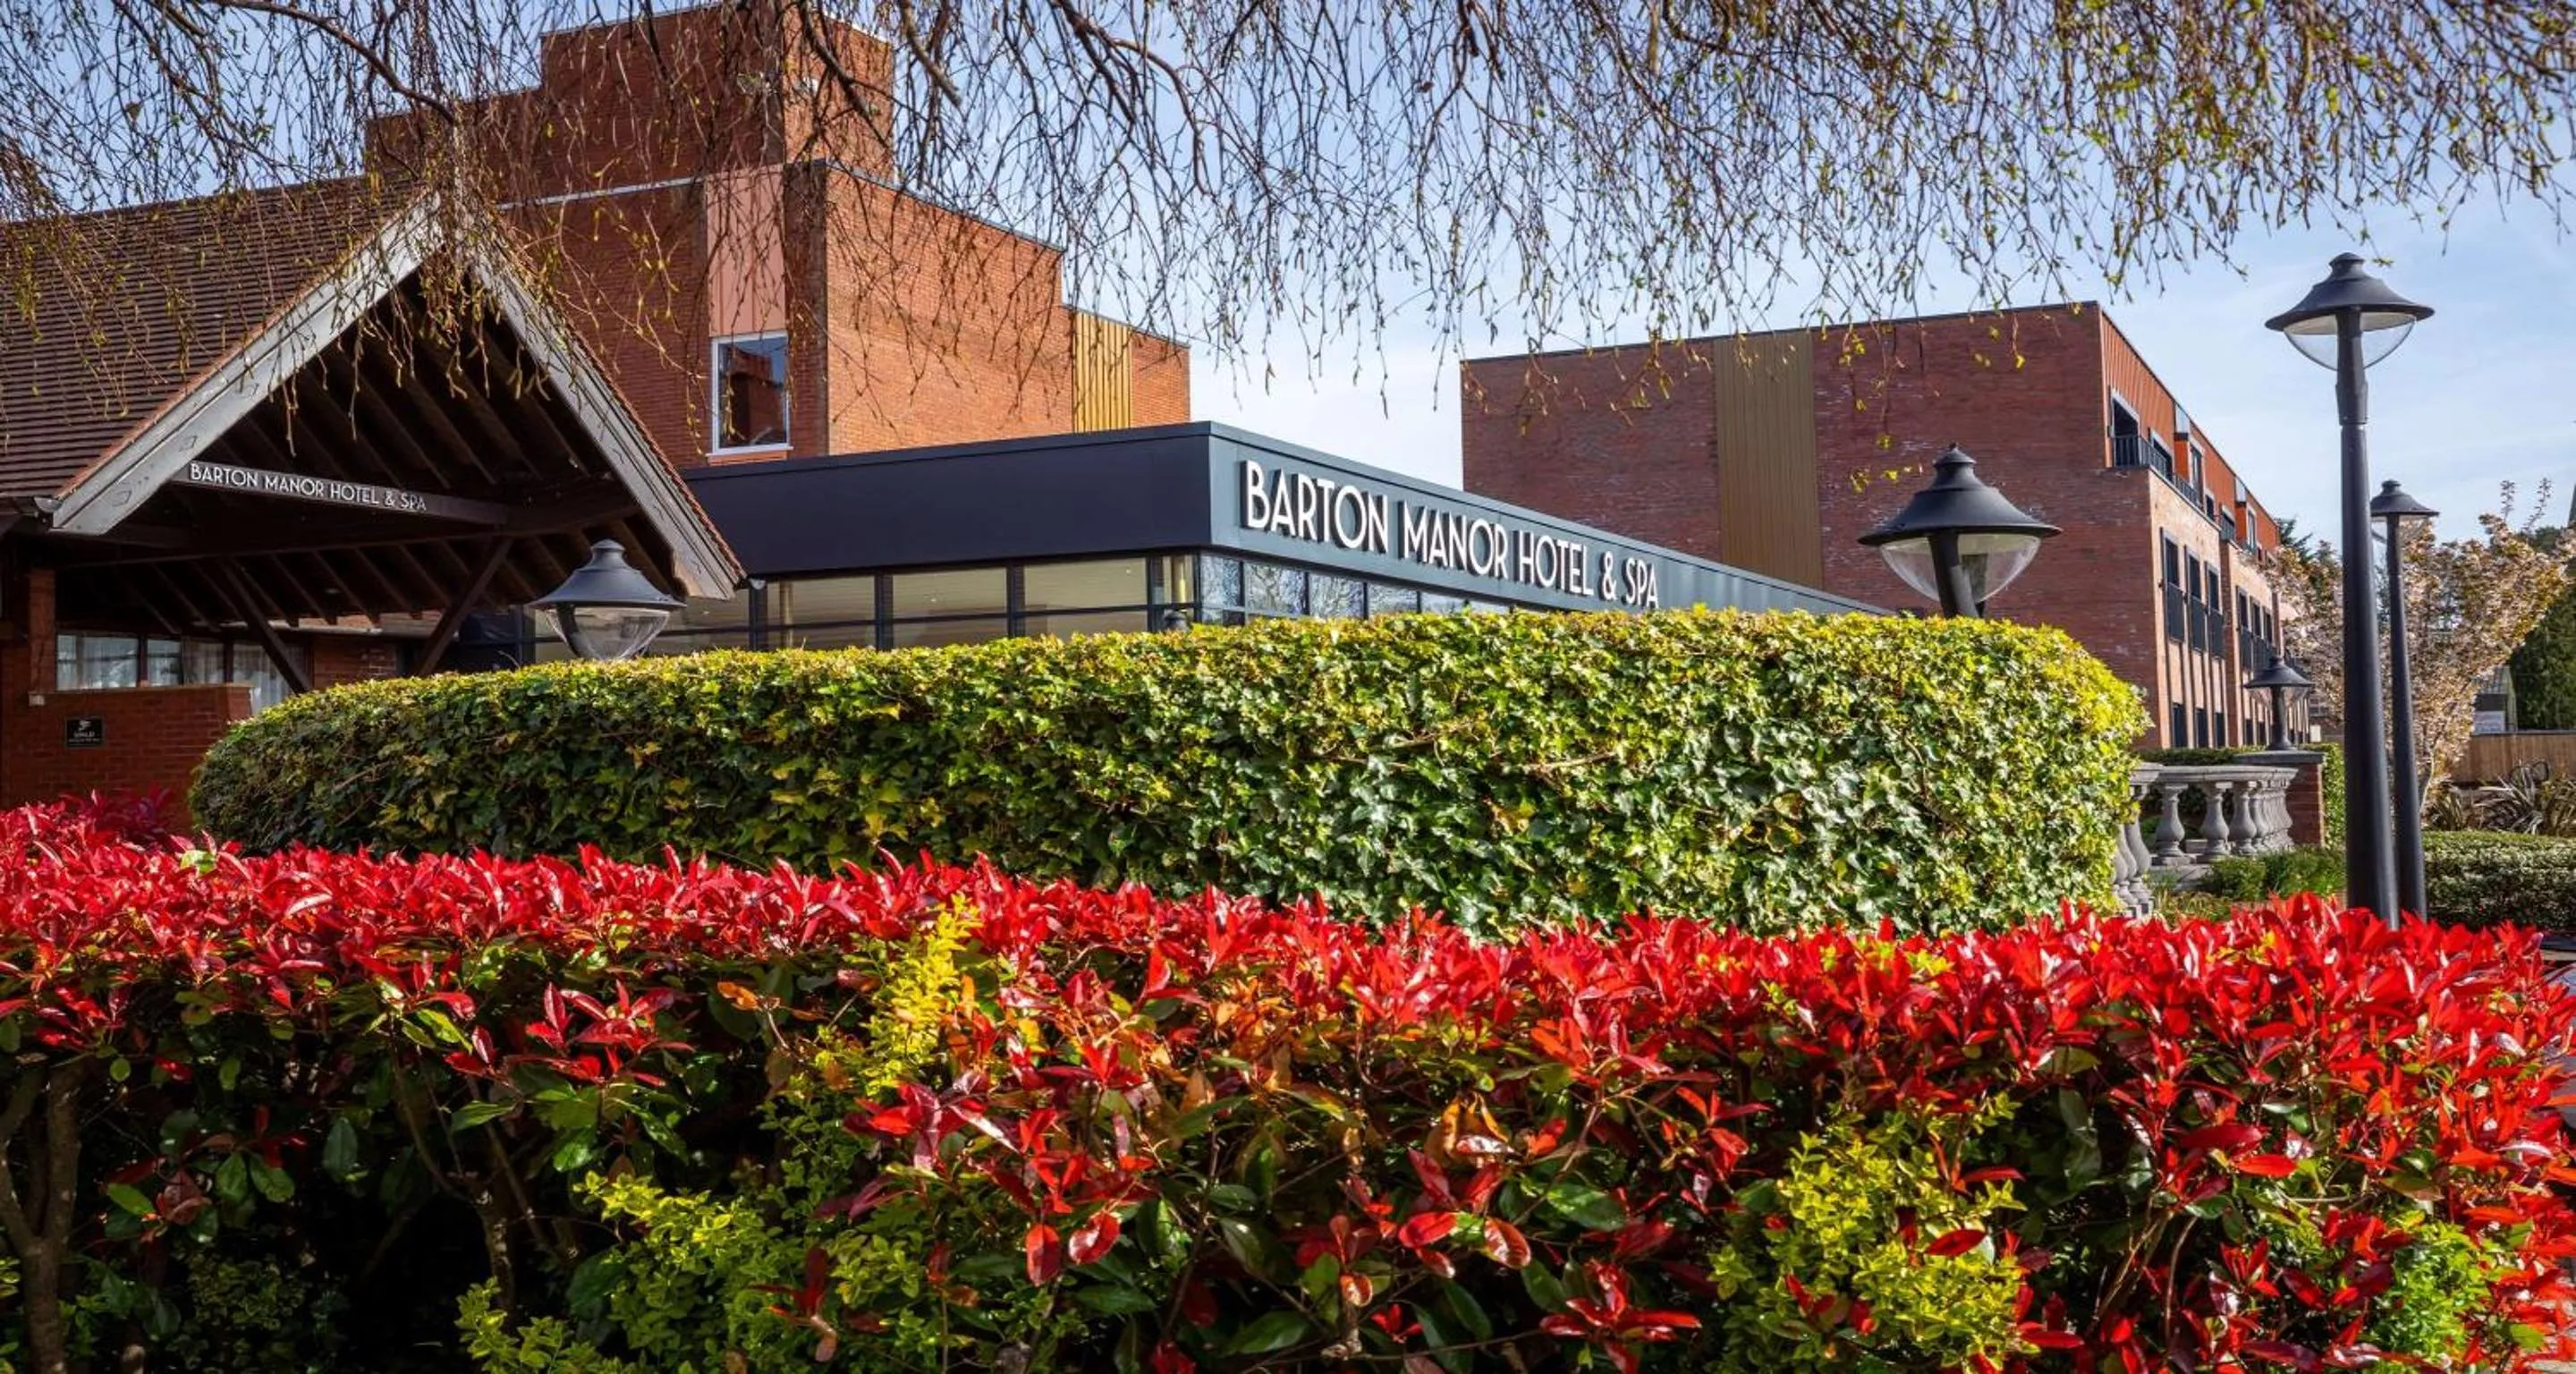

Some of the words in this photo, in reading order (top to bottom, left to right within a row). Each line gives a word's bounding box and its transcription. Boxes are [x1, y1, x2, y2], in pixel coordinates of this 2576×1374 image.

[190, 462, 258, 488] BARTON
[264, 474, 325, 497] MANOR
[330, 483, 379, 505] HOTEL
[385, 491, 396, 507] &
[400, 492, 427, 512] SPA
[1244, 460, 1389, 554] BARTON
[1402, 500, 1510, 581] MANOR
[1519, 530, 1595, 597] HOTEL
[1601, 550, 1617, 602] &
[1624, 557, 1659, 609] SPA
